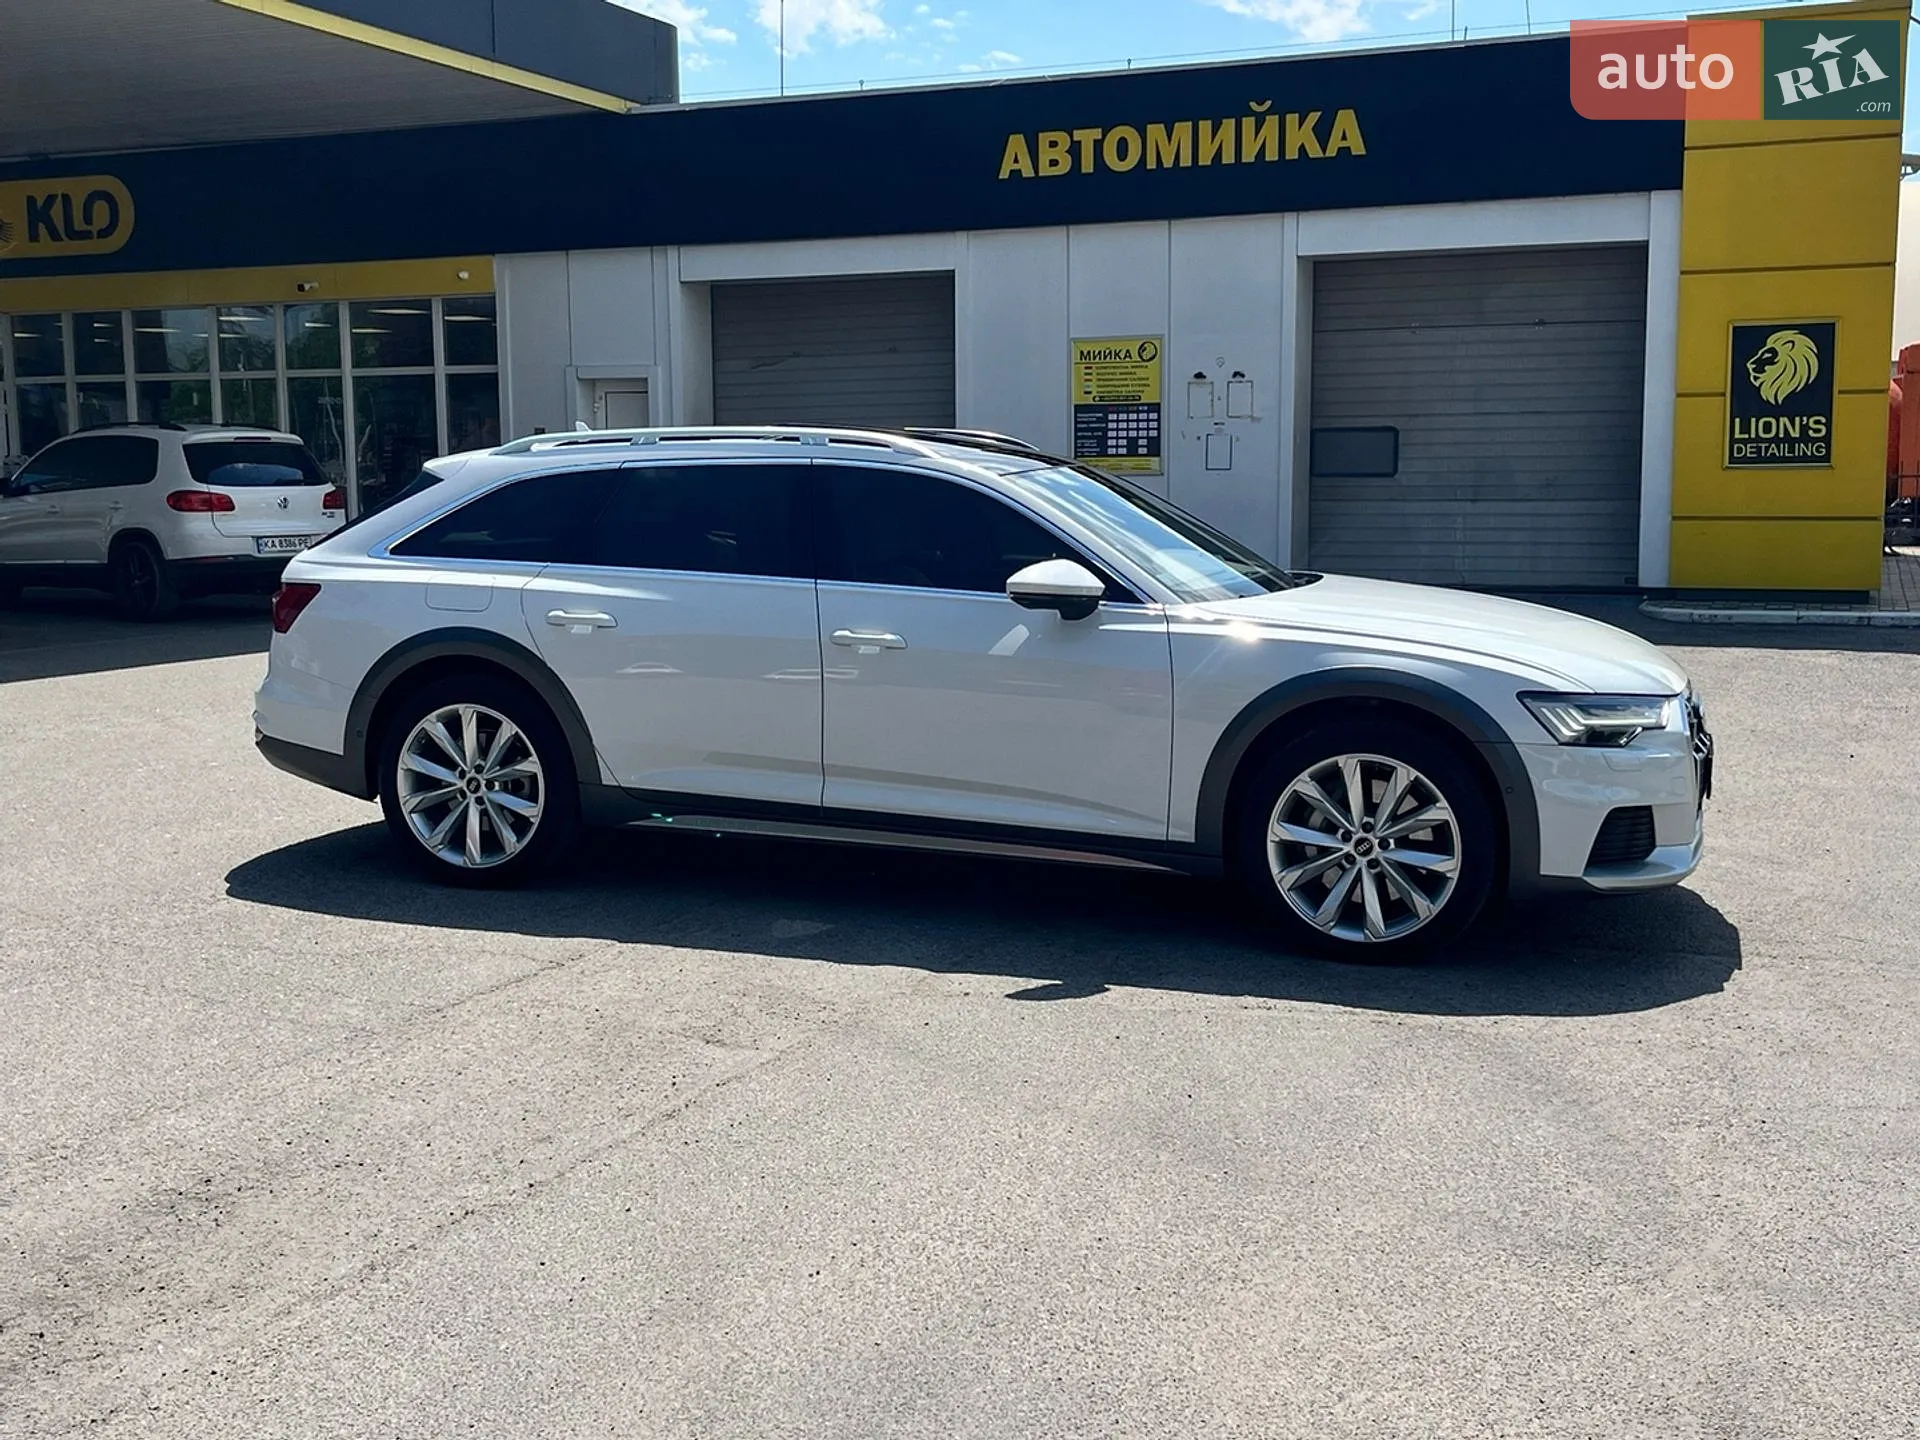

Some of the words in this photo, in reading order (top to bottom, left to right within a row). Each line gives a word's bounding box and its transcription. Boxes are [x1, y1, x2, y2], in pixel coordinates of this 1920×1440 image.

[999, 101, 1367, 179] АВТОМИЙКА
[26, 189, 120, 243] KLO
[1080, 347, 1133, 361] МИЙКА
[1734, 416, 1827, 439] LION'S
[1733, 442, 1827, 458] DETAILING
